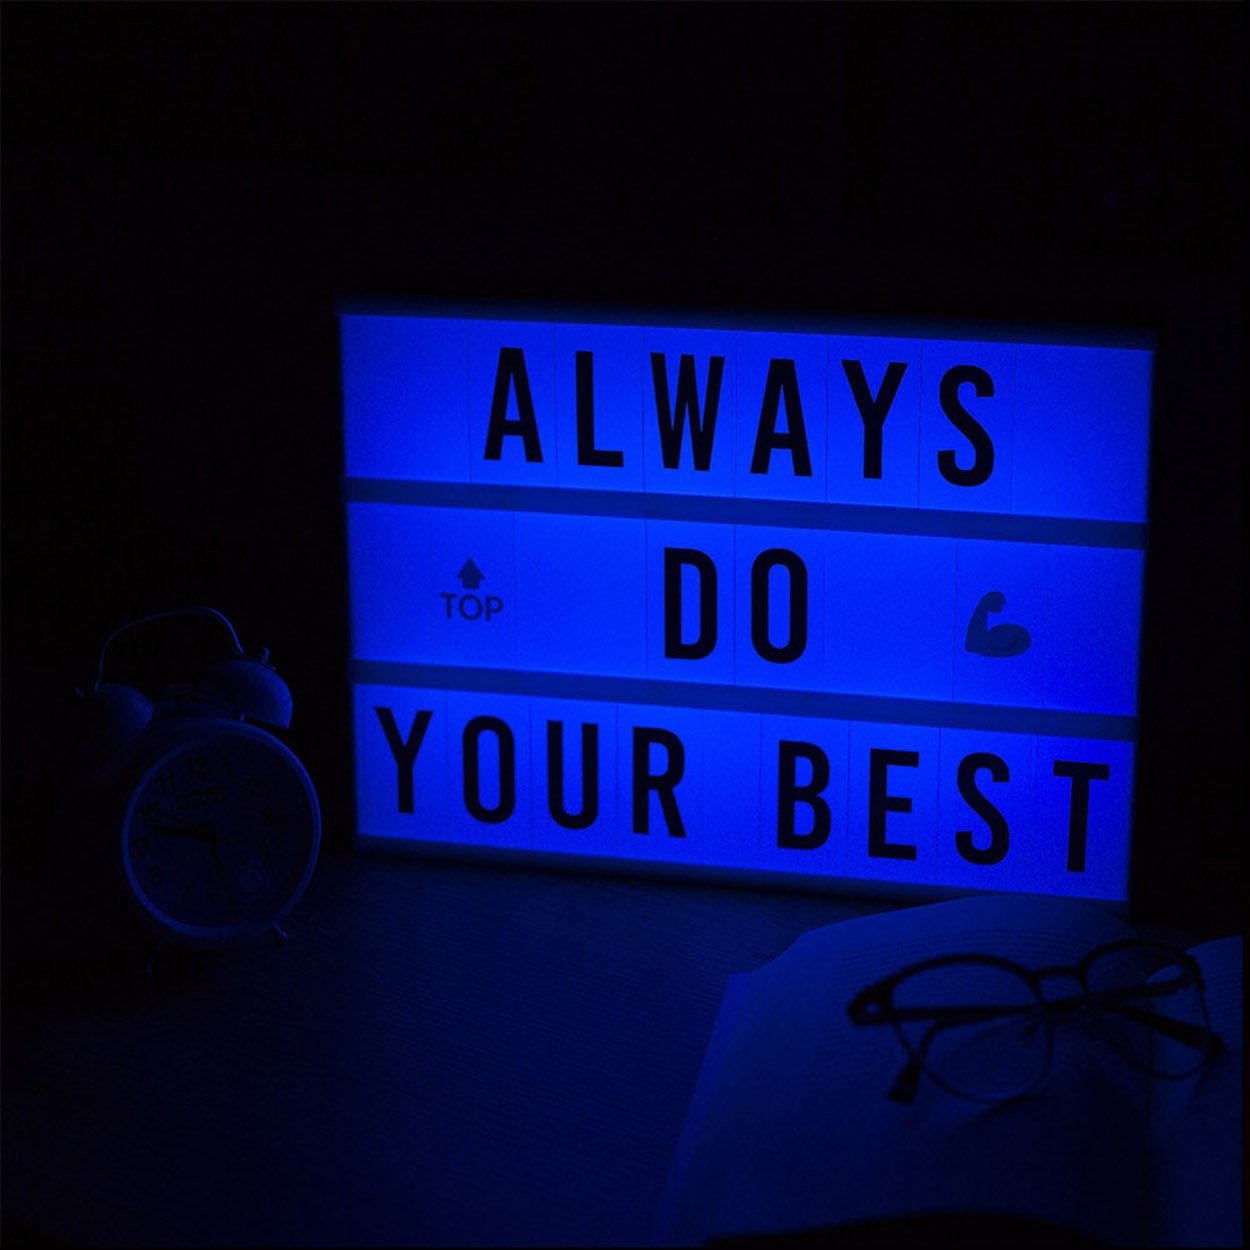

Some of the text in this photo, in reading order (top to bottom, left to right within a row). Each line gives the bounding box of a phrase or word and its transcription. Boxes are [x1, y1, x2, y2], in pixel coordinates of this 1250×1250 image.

[484, 347, 994, 486] ALWAYS
[440, 592, 504, 621] TOP
[664, 548, 807, 664] DO
[375, 707, 686, 838] YOUR
[777, 740, 1110, 873] BEST
